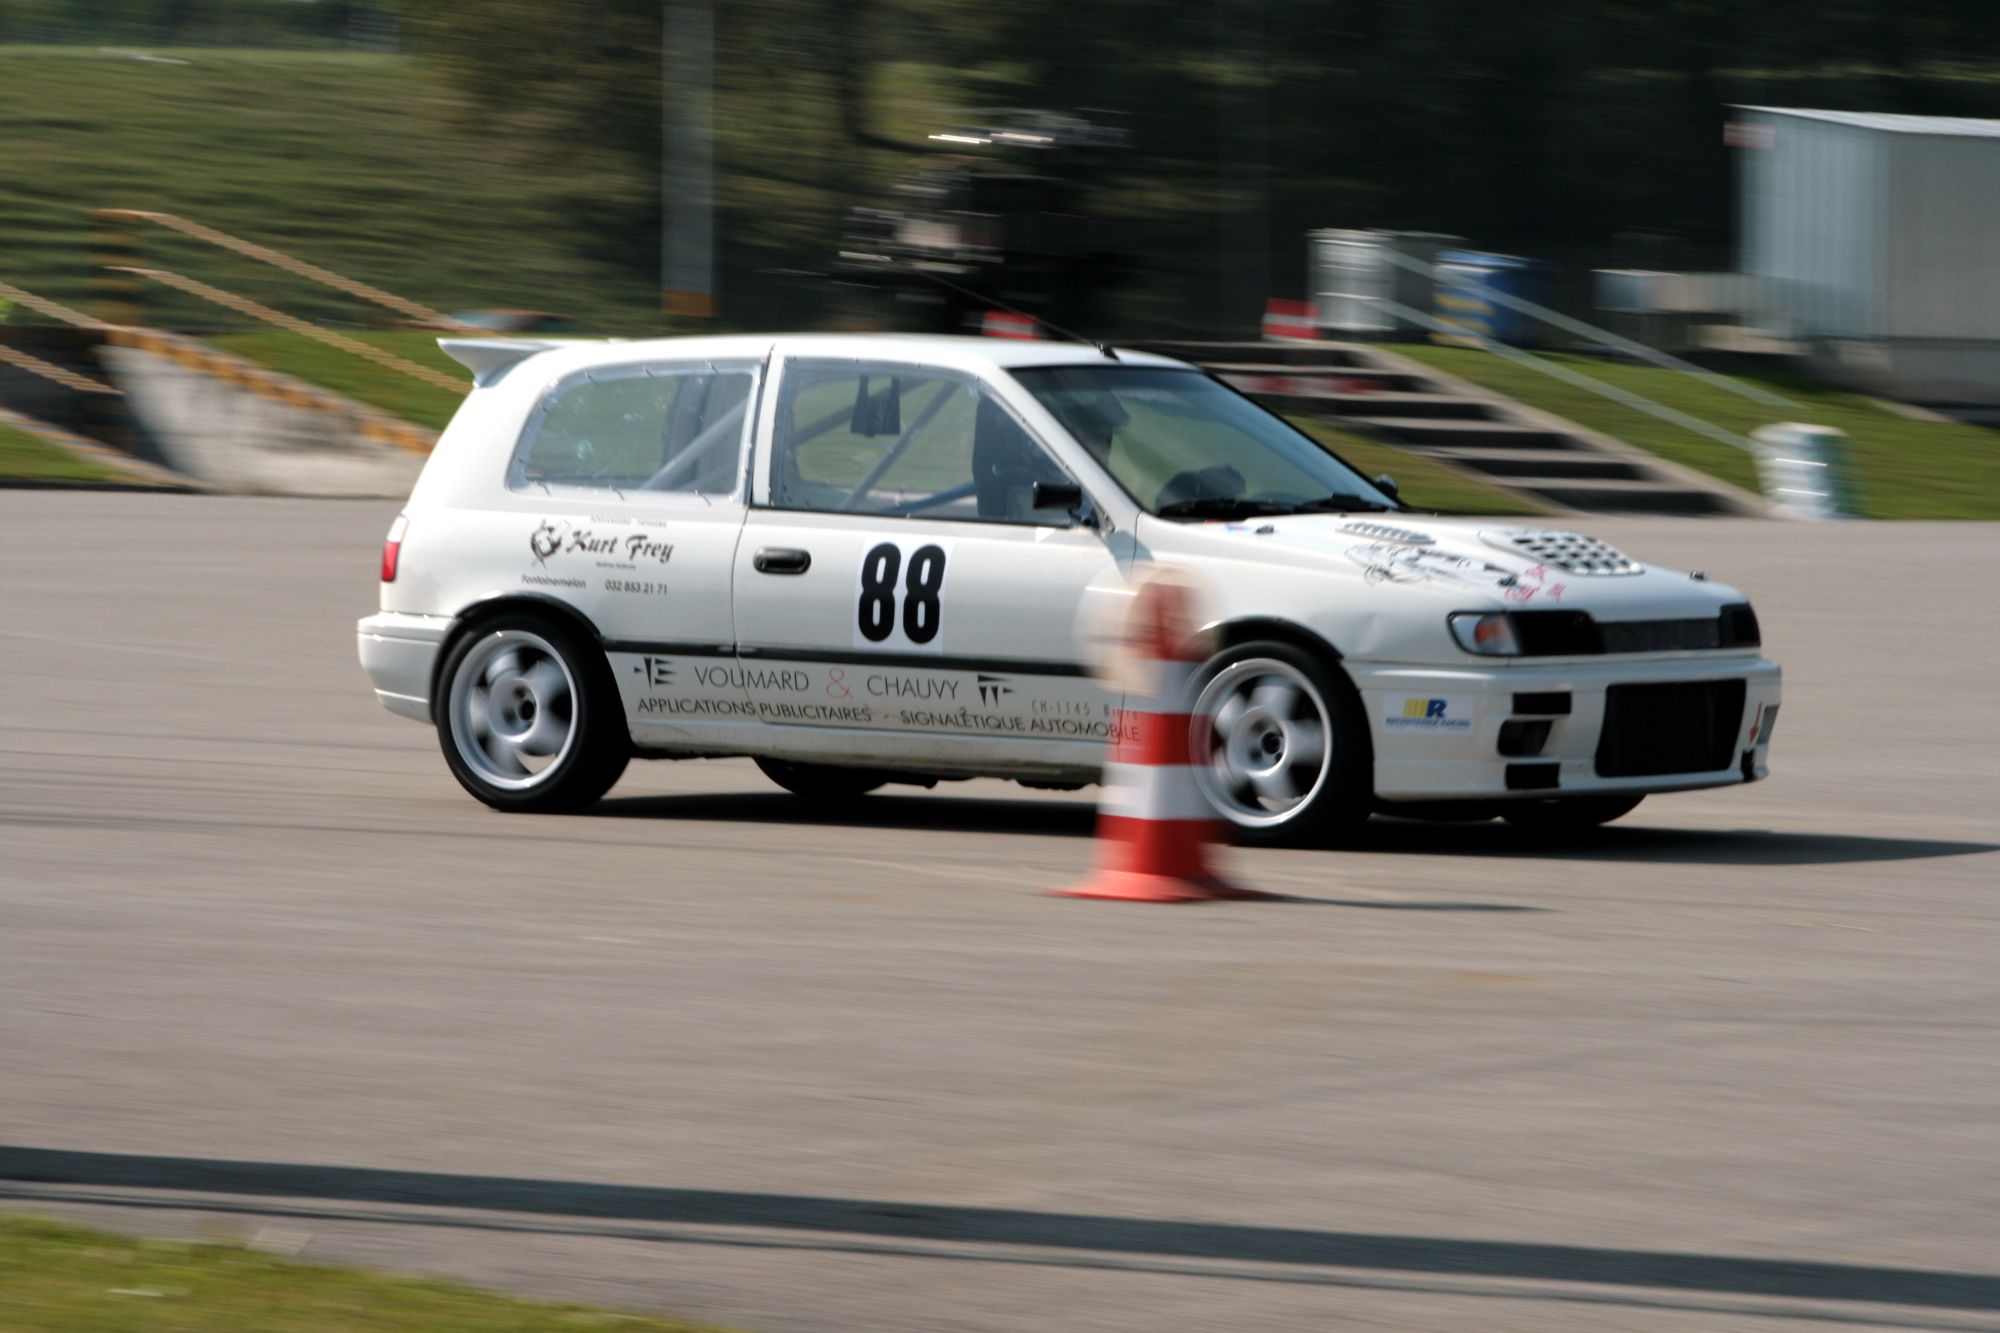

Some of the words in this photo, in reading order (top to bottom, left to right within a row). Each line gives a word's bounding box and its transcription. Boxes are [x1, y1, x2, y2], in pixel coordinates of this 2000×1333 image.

[565, 529, 618, 554] Kurt
[625, 534, 675, 564] Frey
[604, 578, 622, 592] 032
[624, 581, 642, 593] 853
[643, 582, 654, 594] 21
[656, 583, 668, 595] 71
[858, 541, 946, 645] 88
[694, 666, 810, 692] VOUMARD
[825, 666, 853, 699] &
[866, 674, 959, 700] CHAUVY
[636, 697, 756, 717] APPLICATIONS
[758, 702, 872, 723] PUBLICITAIRES
[899, 706, 1026, 733] SIGNALÉTIQUE
[1030, 718, 1141, 741] AUTOMOBILE
